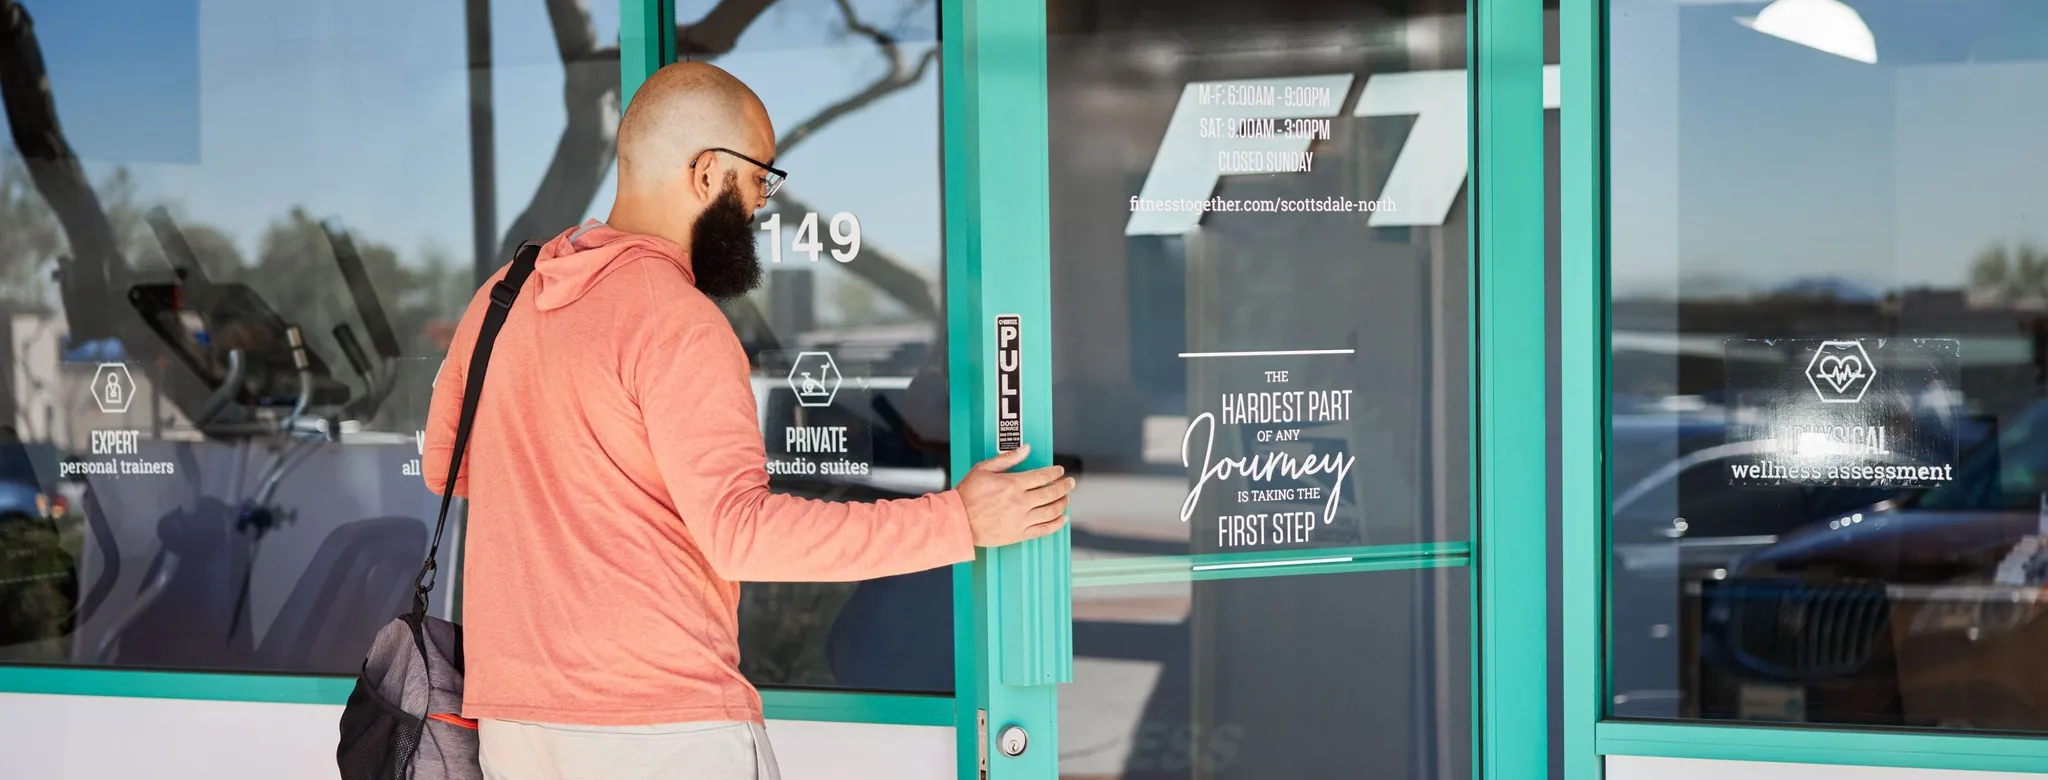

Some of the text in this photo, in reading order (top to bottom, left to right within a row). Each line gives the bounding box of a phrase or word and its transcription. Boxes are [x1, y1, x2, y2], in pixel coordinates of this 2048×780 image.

[1199, 84, 1226, 106] M-F:
[1228, 85, 1275, 107] 6:00AM
[1285, 86, 1330, 107] 9:00PM
[1200, 117, 1225, 139] SAT:
[1284, 118, 1330, 140] 3:00PM
[1218, 150, 1314, 172] CLOSED SUNDAY
[1129, 194, 1397, 214] fitnesstogether.com/scottsdale-north
[760, 212, 861, 263] 149
[1000, 326, 1018, 419] PULL
[1264, 370, 1289, 383] THE
[1222, 389, 1353, 425] HARDEST PART
[91, 430, 139, 455] EXPERT
[786, 426, 848, 453] PRIVATE
[1257, 429, 1300, 442] OF ANY
[1793, 425, 1889, 455] PSICAL
[60, 458, 174, 477] personal trainers
[402, 459, 421, 476] all
[766, 457, 869, 475] studio suites
[1180, 412, 1355, 524] Journey
[1731, 460, 1953, 482] wellness assessment
[1237, 487, 1321, 503] IS TAKING THE
[1218, 513, 1268, 547] FIRST
[1272, 511, 1316, 544] STEP
